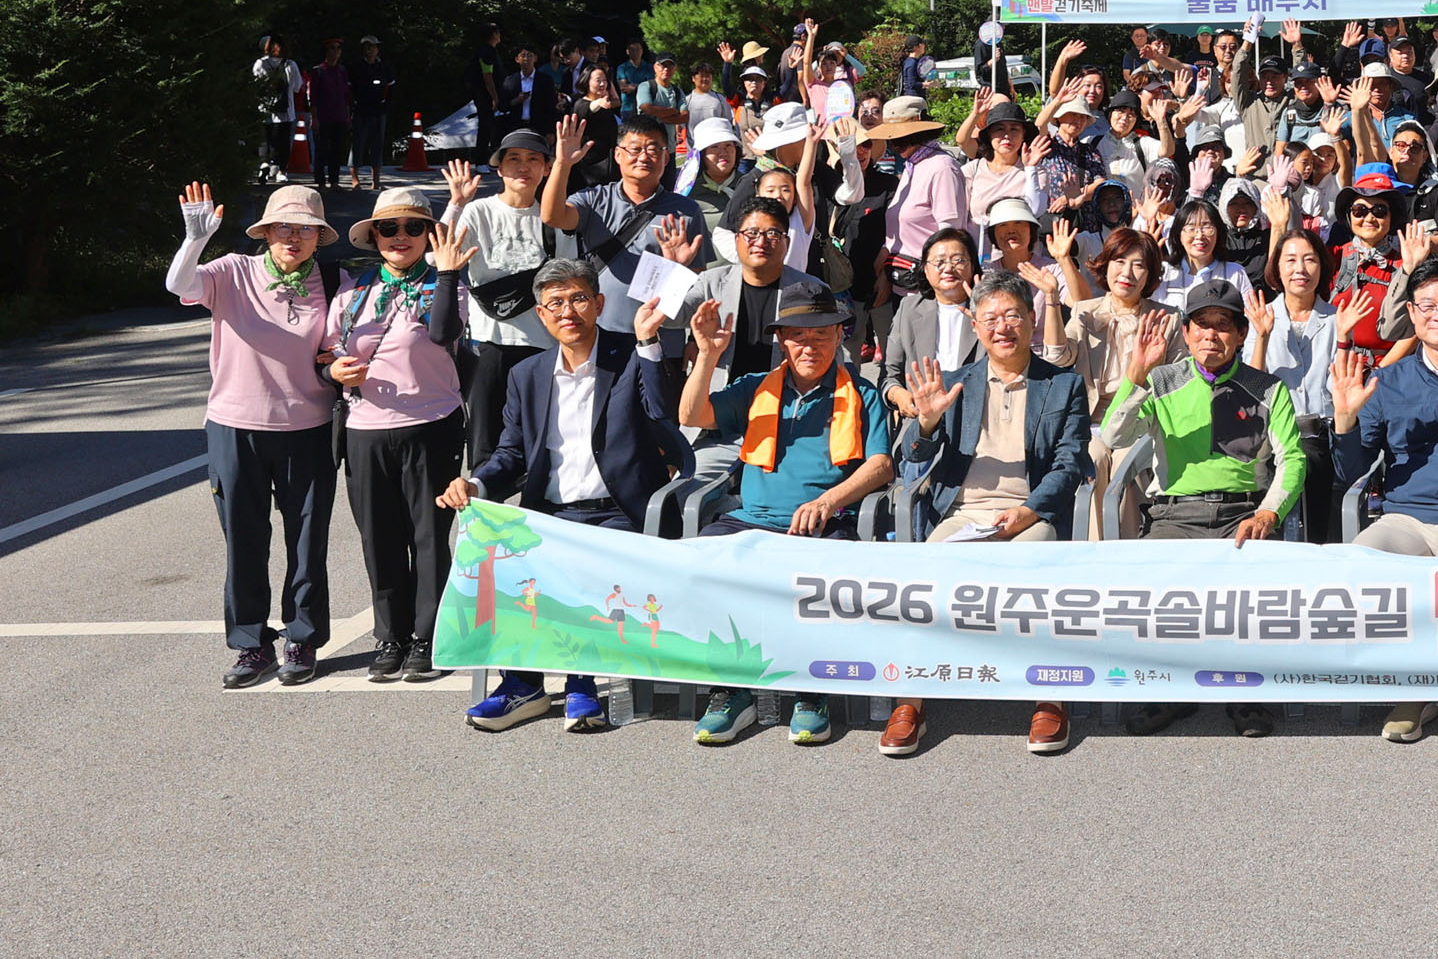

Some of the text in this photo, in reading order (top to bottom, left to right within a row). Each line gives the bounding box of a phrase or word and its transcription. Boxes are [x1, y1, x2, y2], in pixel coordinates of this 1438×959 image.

[795, 576, 934, 624] 2026
[951, 585, 1408, 640] 원주운곡솔바람숲길
[1036, 668, 1084, 683] 재정지원
[1134, 669, 1171, 684] 원주시
[1273, 673, 1401, 686] (사)한국걷기협회,
